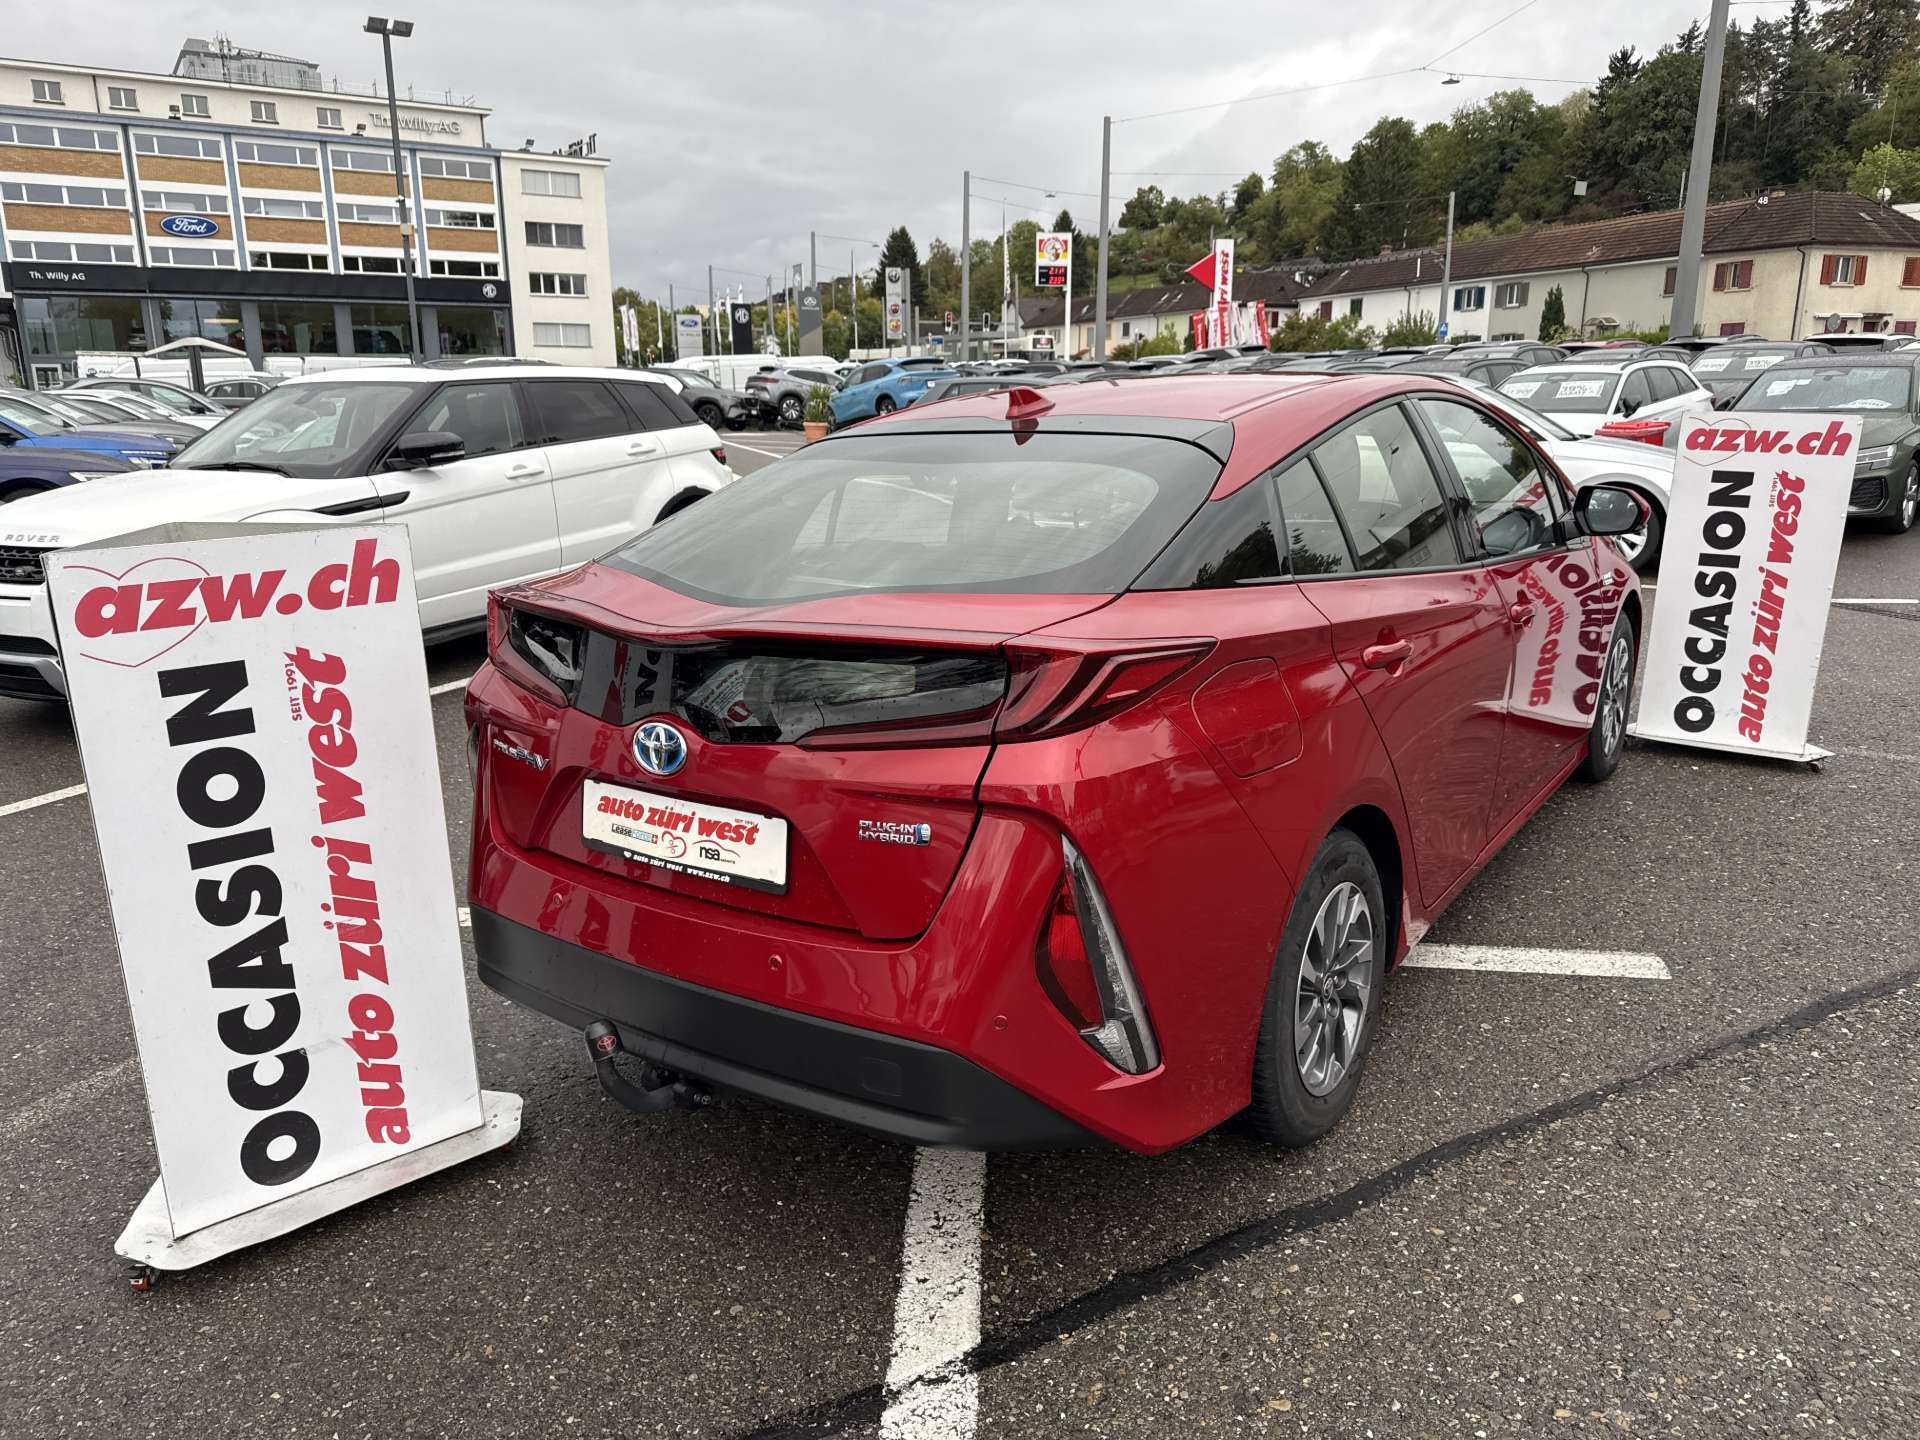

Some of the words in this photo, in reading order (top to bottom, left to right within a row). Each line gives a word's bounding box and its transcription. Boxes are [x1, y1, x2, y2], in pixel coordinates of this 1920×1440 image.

[397, 112, 434, 135] Willy
[438, 119, 462, 135] AG
[1758, 196, 1769, 204] 48
[172, 217, 208, 233] Ford
[28, 271, 44, 280] Th.
[45, 271, 69, 282] Willy
[71, 272, 86, 281] AG
[1685, 421, 1853, 456] azw.ch
[1766, 469, 1806, 564] west
[4, 534, 61, 543] ROVER
[74, 538, 400, 638] azw.ch
[1674, 470, 1755, 733] OCCASION
[1750, 566, 1789, 656] züri
[284, 662, 298, 692] 1991
[289, 696, 302, 722] SEIT
[1738, 654, 1773, 743] auto
[283, 646, 366, 825] west
[597, 795, 645, 821] auto
[647, 806, 697, 834] züri
[697, 816, 760, 845] west
[859, 820, 917, 834] PLUG-IN
[858, 829, 915, 845] HYBRID
[633, 854, 649, 864] auto
[649, 858, 665, 869] züri
[666, 863, 683, 873] west
[686, 867, 731, 883] www.azw.ch
[699, 846, 720, 861] nsa
[157, 659, 321, 1187] OCCASION
[310, 835, 389, 985] züri
[341, 993, 411, 1145] auto
